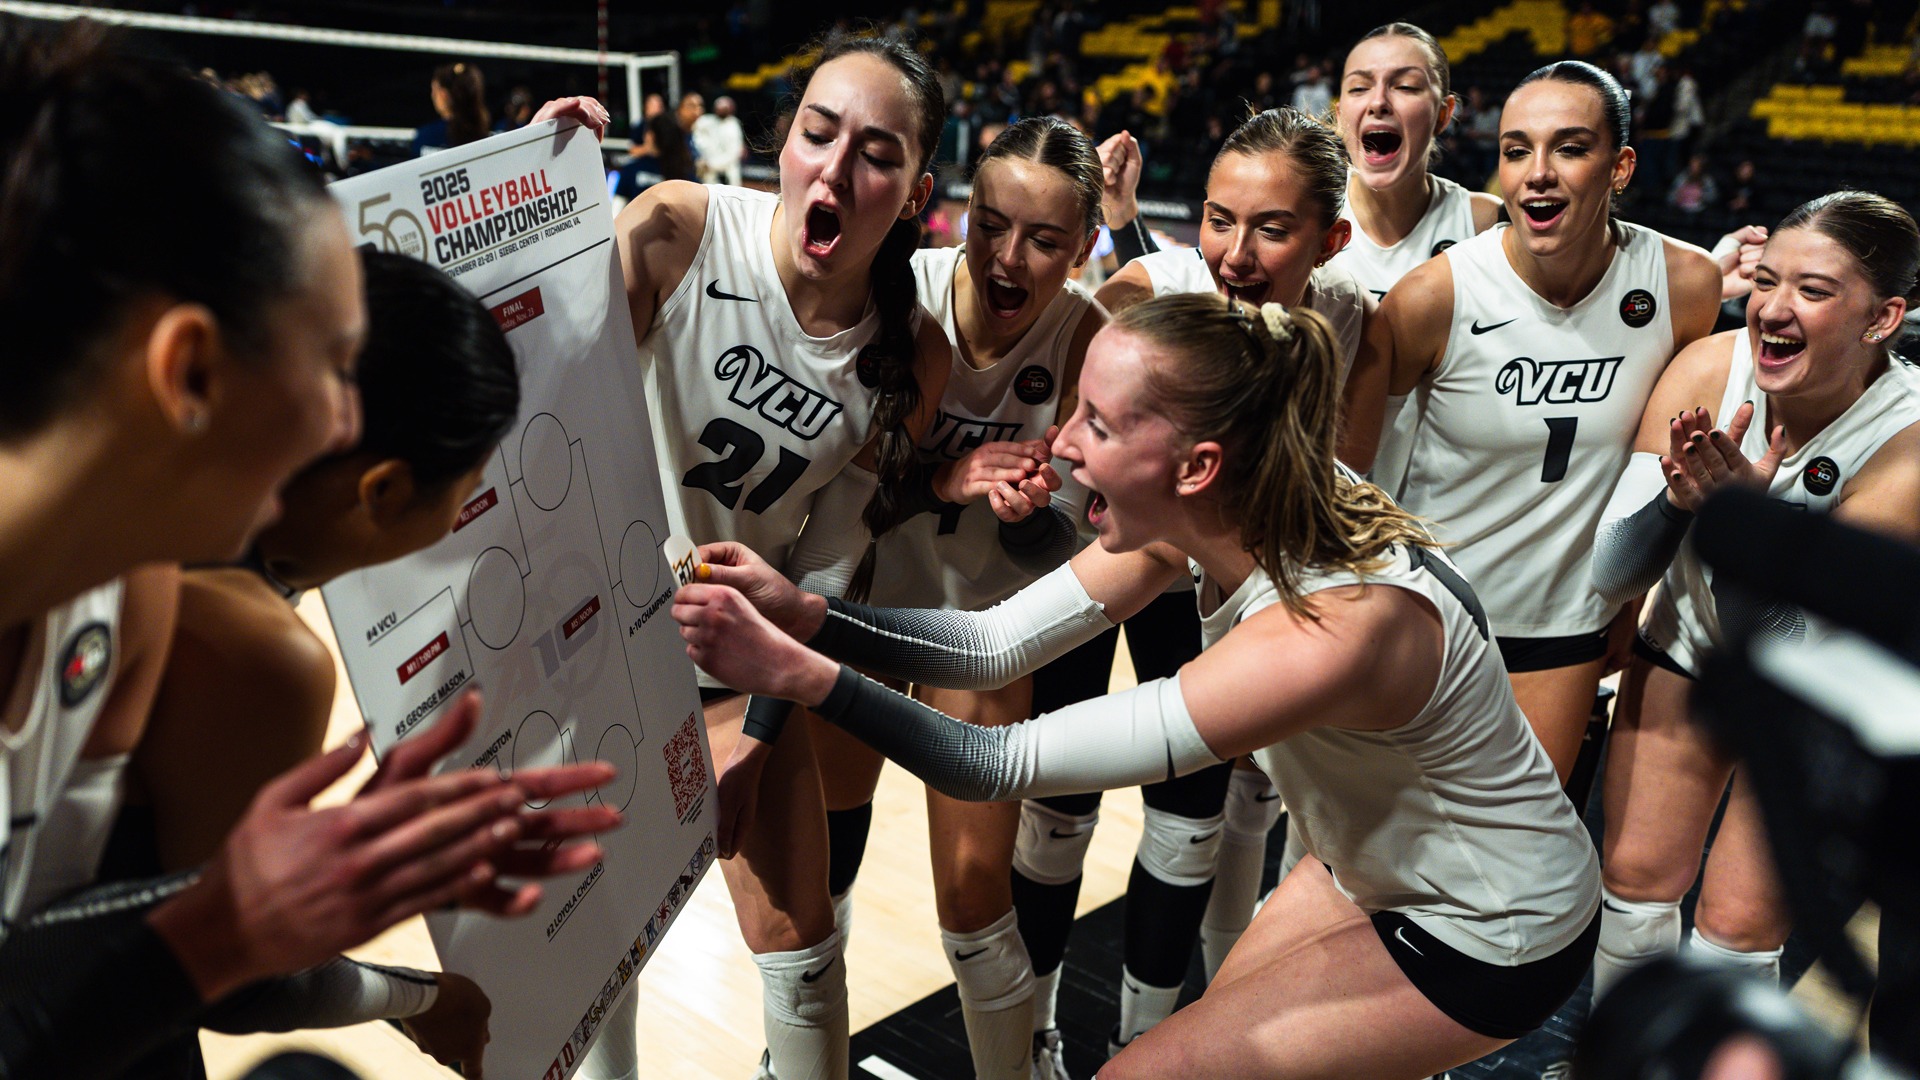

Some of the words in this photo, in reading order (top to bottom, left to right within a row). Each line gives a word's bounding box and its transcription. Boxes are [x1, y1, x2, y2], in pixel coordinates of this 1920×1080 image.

[421, 168, 471, 205] 2025
[426, 169, 552, 235] VOLLEYBALL
[435, 186, 578, 264] CHAMPIONSHIP
[499, 243, 519, 258] SIEGEL
[519, 233, 540, 249] CENTER
[502, 300, 524, 317] FINAL
[714, 344, 844, 441] VCU
[1495, 356, 1625, 406] VCU
[681, 417, 811, 516] 21
[1541, 416, 1578, 483] 1
[471, 498, 488, 515] NOON
[366, 625, 378, 641] #4
[377, 611, 397, 632] VCU
[579, 605, 593, 622] NOON
[629, 618, 642, 638] A-10
[641, 587, 672, 624] CHAMPIONS
[395, 720, 406, 736] #5
[406, 693, 438, 726] GEORGE
[437, 669, 466, 700] MASON
[471, 729, 512, 770] SHINGTON
[546, 923, 555, 938] #2
[553, 894, 578, 928] LOYOLA
[577, 862, 602, 898] CHICAGO
